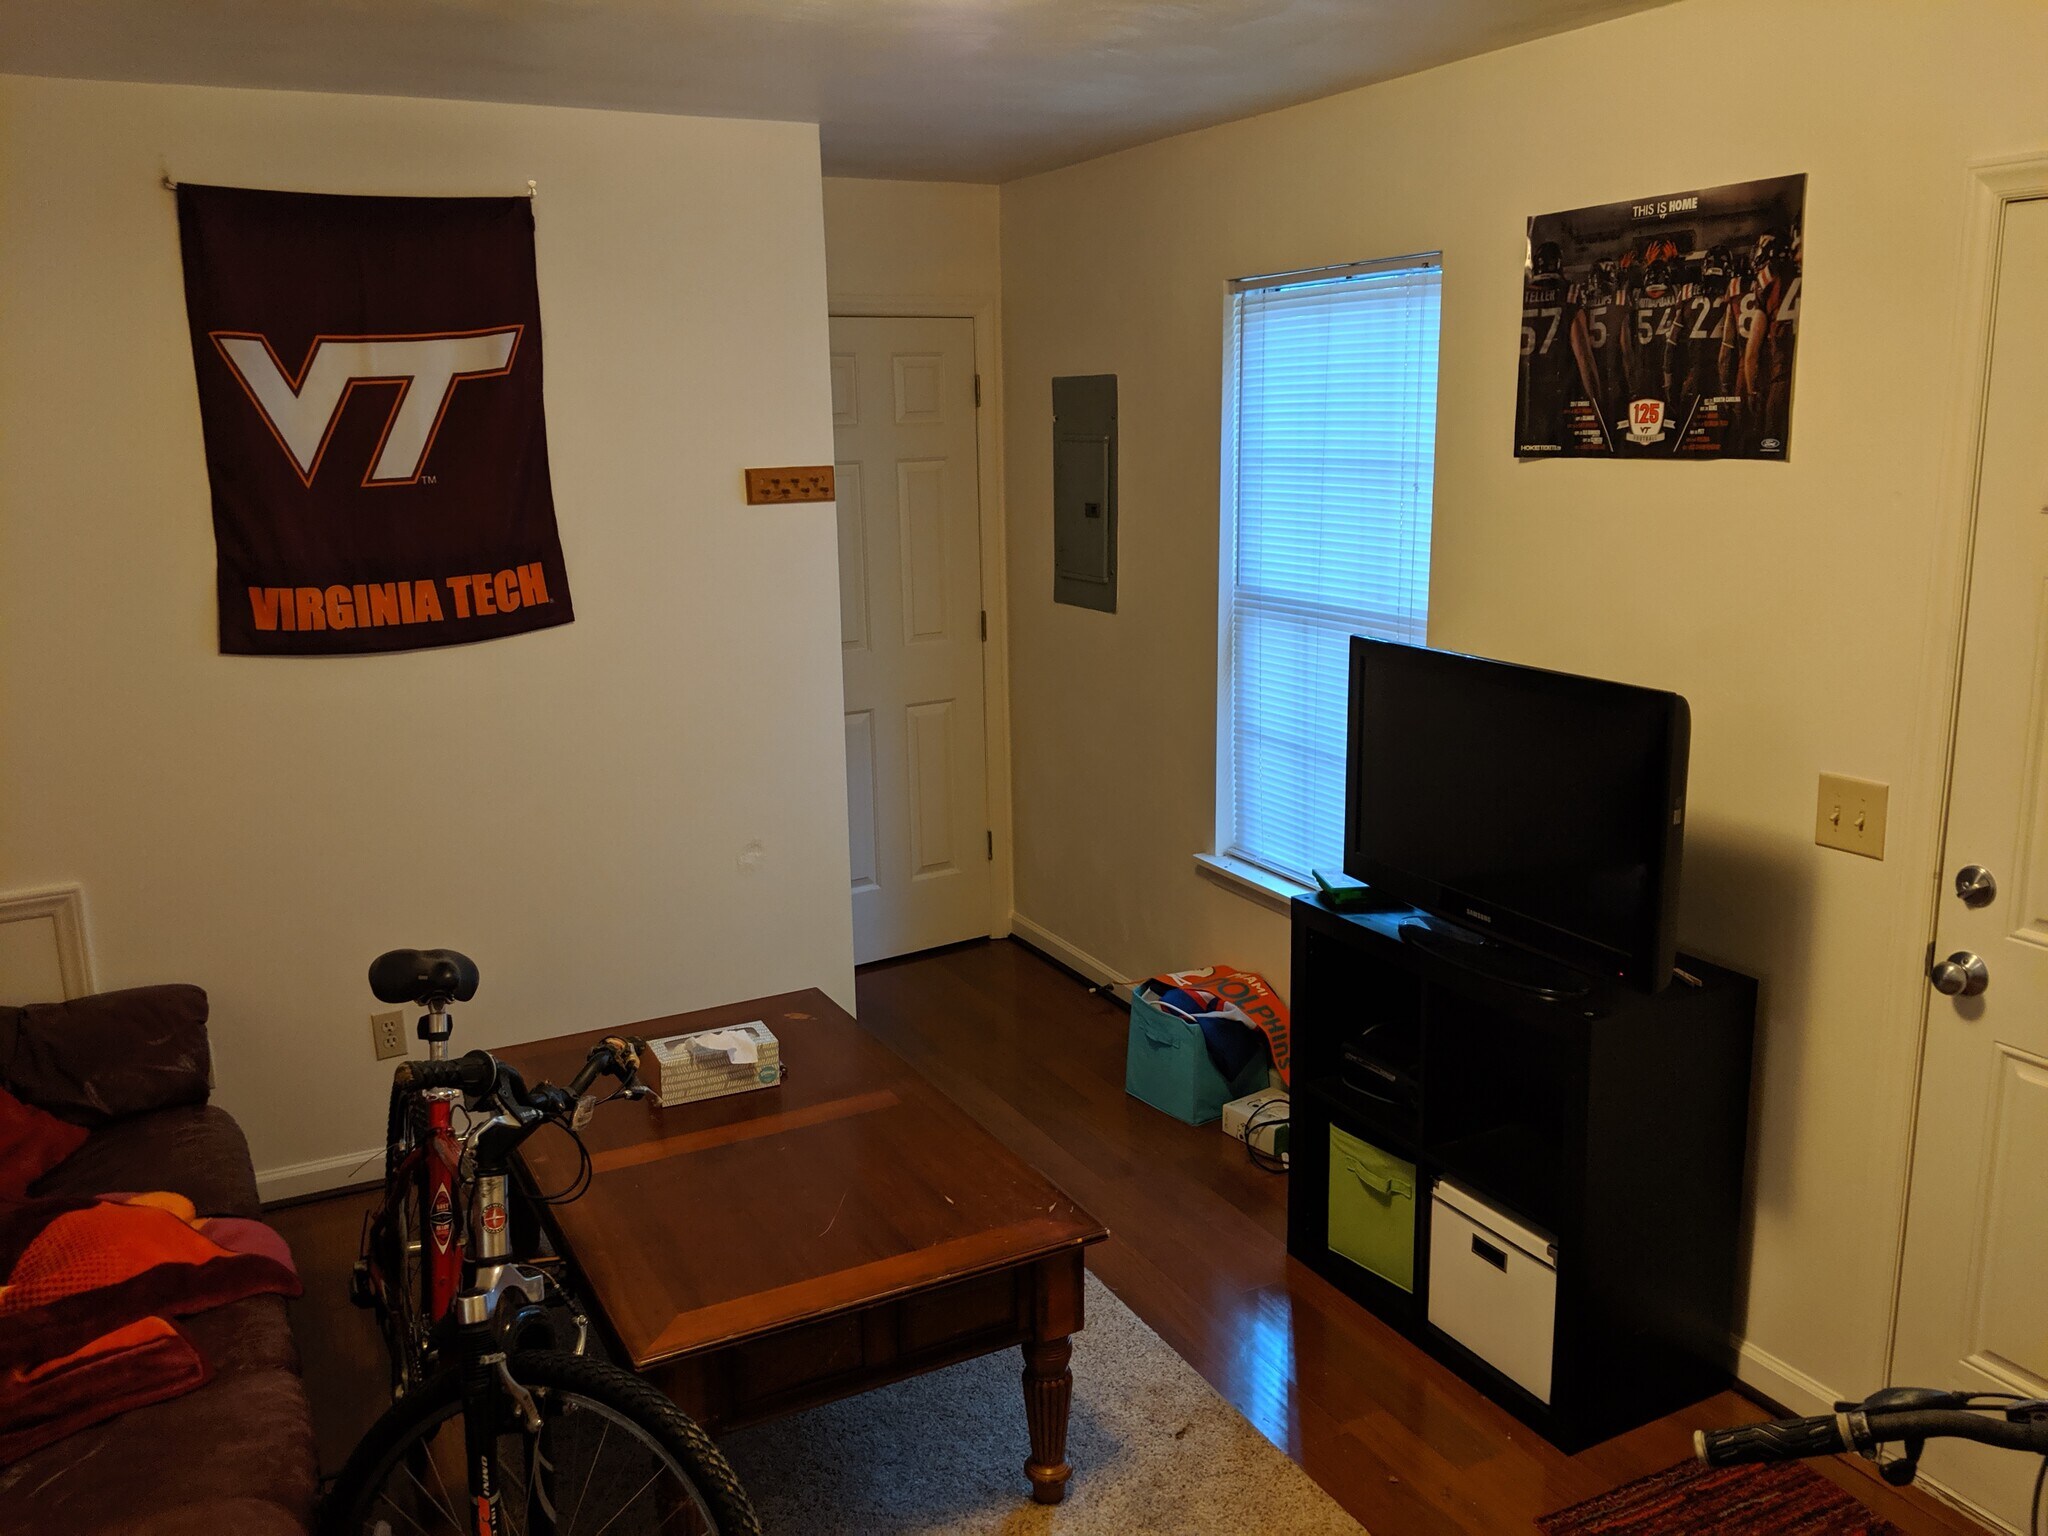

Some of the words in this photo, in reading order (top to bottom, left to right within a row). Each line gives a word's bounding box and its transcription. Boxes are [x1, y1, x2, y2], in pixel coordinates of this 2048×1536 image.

[1632, 203, 1654, 218] THIS
[1656, 201, 1667, 214] IS
[1668, 197, 1698, 213] HOME
[1520, 306, 1562, 356] 57
[1590, 306, 1607, 349] 5
[1637, 307, 1672, 345] 54
[1689, 296, 1728, 339] 22
[208, 324, 525, 488] VT
[1634, 403, 1660, 424] 125
[1640, 426, 1652, 434] VT
[421, 475, 437, 485] TM
[248, 579, 443, 631] VIRGINIA
[446, 562, 550, 618] TECH
